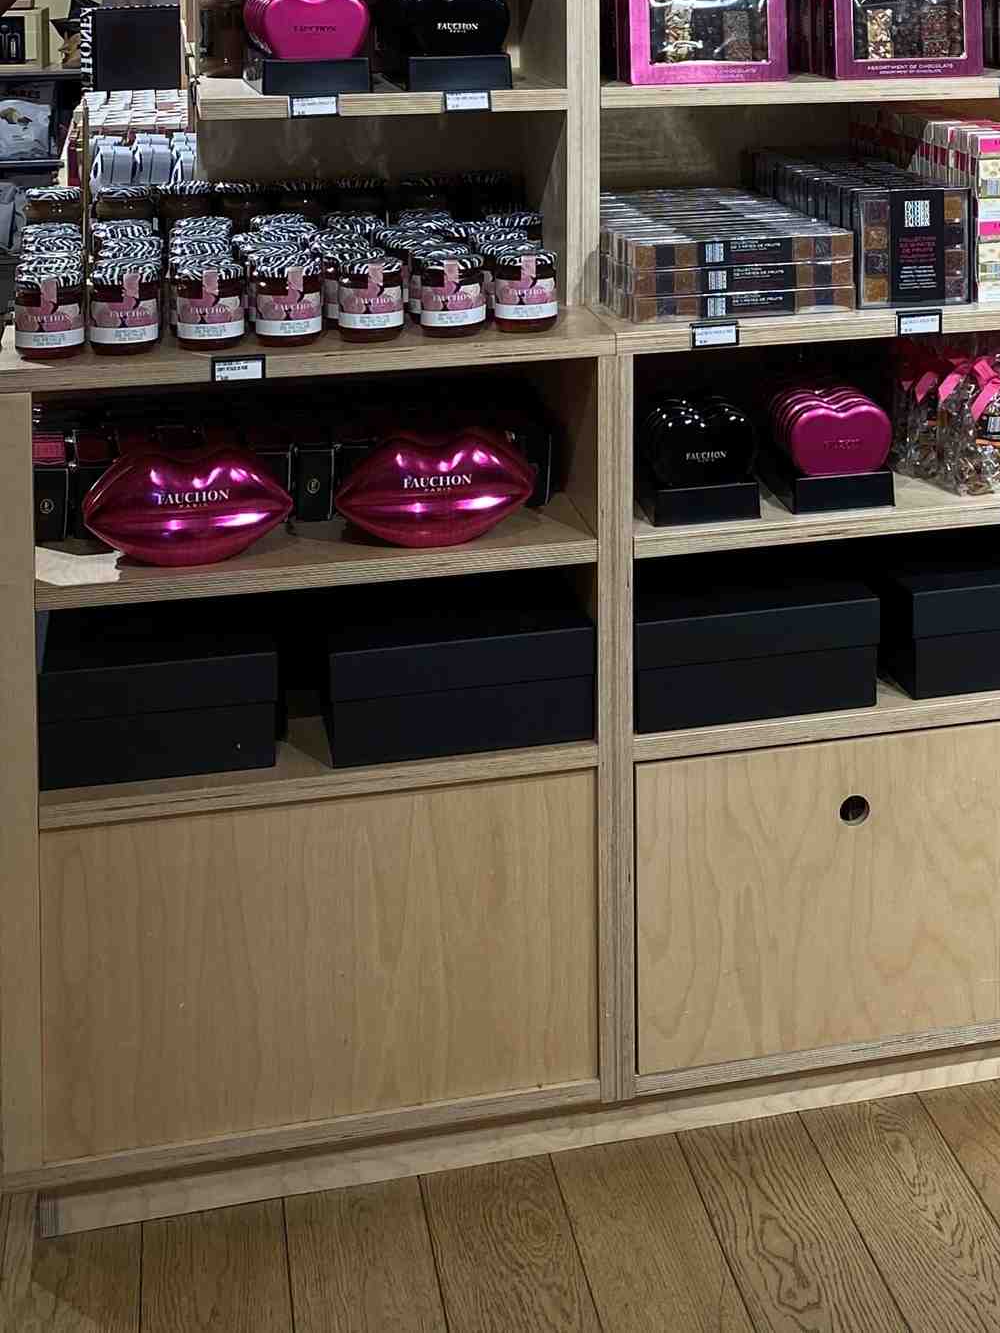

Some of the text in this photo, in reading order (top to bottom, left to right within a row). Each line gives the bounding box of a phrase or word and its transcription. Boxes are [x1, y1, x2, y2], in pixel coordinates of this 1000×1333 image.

[437, 21, 479, 30] FAUCHON
[686, 450, 728, 460] FAUCHON
[402, 473, 473, 489] FAUCHON
[156, 489, 230, 505] FAUCHON
